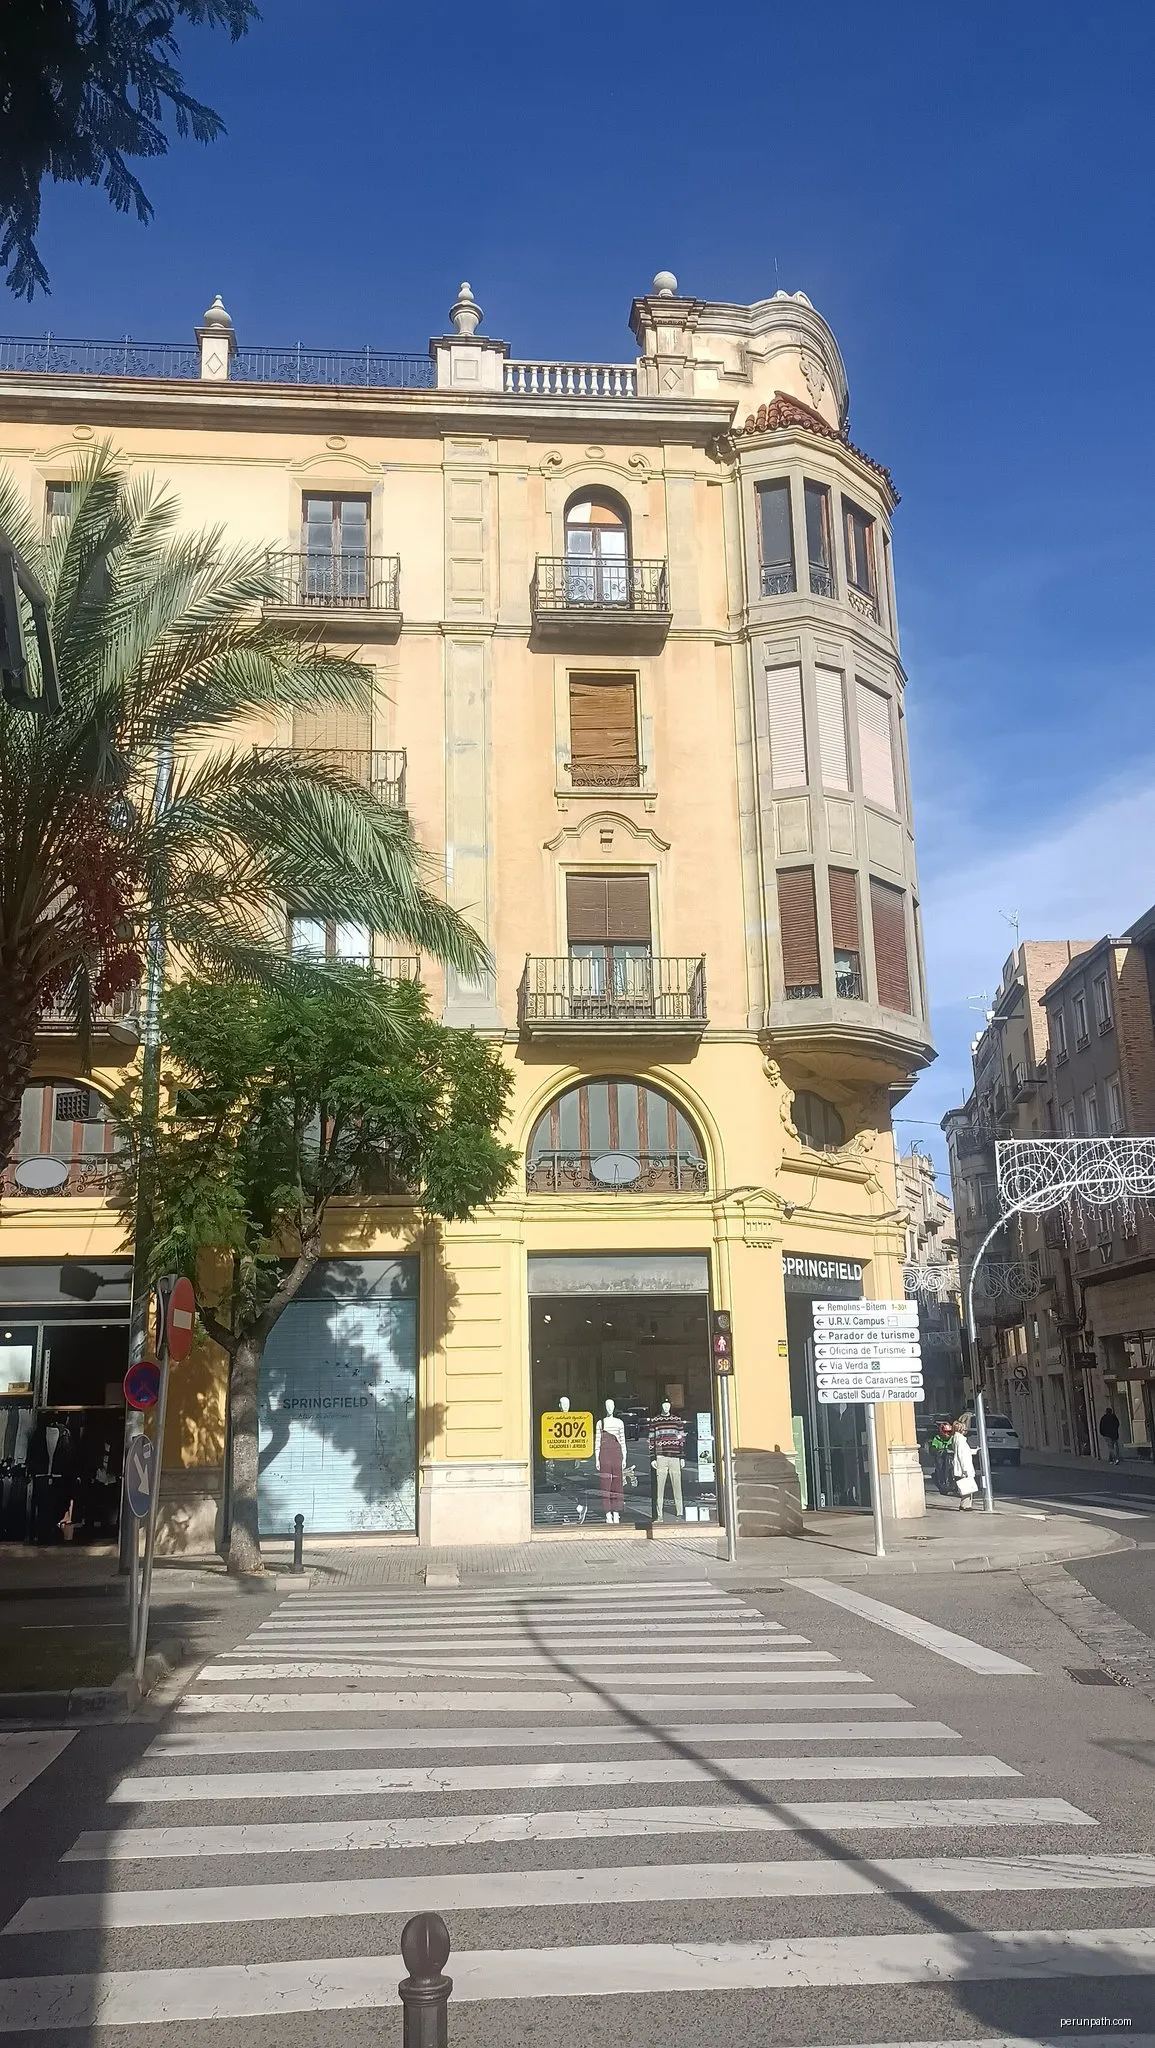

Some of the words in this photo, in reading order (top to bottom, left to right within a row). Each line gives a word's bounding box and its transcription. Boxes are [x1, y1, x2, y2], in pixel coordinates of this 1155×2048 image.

[782, 1257, 863, 1281] SPRINGFIELD
[828, 1317, 851, 1326] U.R.V.
[852, 1317, 885, 1328] Campus
[828, 1331, 864, 1340] Parador
[867, 1331, 878, 1340] de
[881, 1330, 915, 1339] turisme
[829, 1346, 858, 1355] Oficina
[860, 1346, 871, 1355] de
[873, 1345, 906, 1354] Turisme
[829, 1361, 843, 1370] Via
[844, 1361, 869, 1370] Verda
[852, 1376, 863, 1385] de
[865, 1375, 909, 1384] Caravanes
[832, 1390, 859, 1400] Castell
[860, 1390, 880, 1399] Suda
[882, 1389, 886, 1398] /
[887, 1390, 918, 1399] Parador
[283, 1396, 369, 1409] SPRINGFIELD
[548, 1421, 587, 1438] -30%
